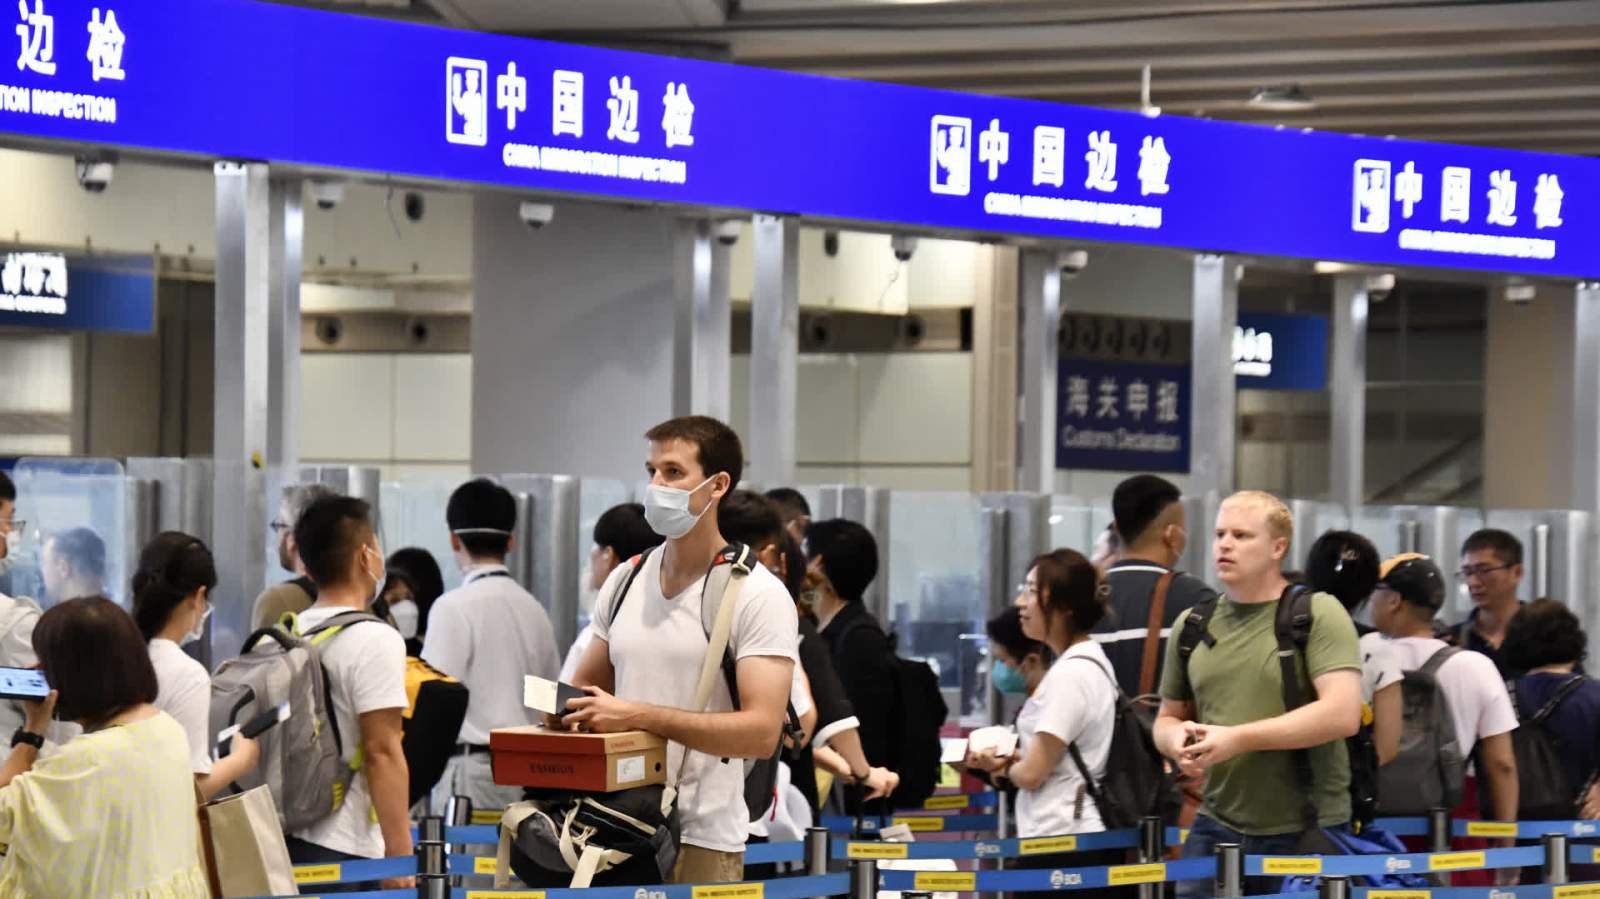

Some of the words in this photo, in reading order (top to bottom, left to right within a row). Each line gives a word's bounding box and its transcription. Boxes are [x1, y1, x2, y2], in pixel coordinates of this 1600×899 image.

[16, 0, 125, 81] 边检
[32, 89, 116, 123] INSPECTION
[497, 62, 694, 147] 中国边检
[979, 118, 1170, 196] 中国边检
[1395, 161, 1564, 229] 中国边检
[1066, 376, 1178, 422] 海关申报
[1119, 428, 1180, 452] Declaration
